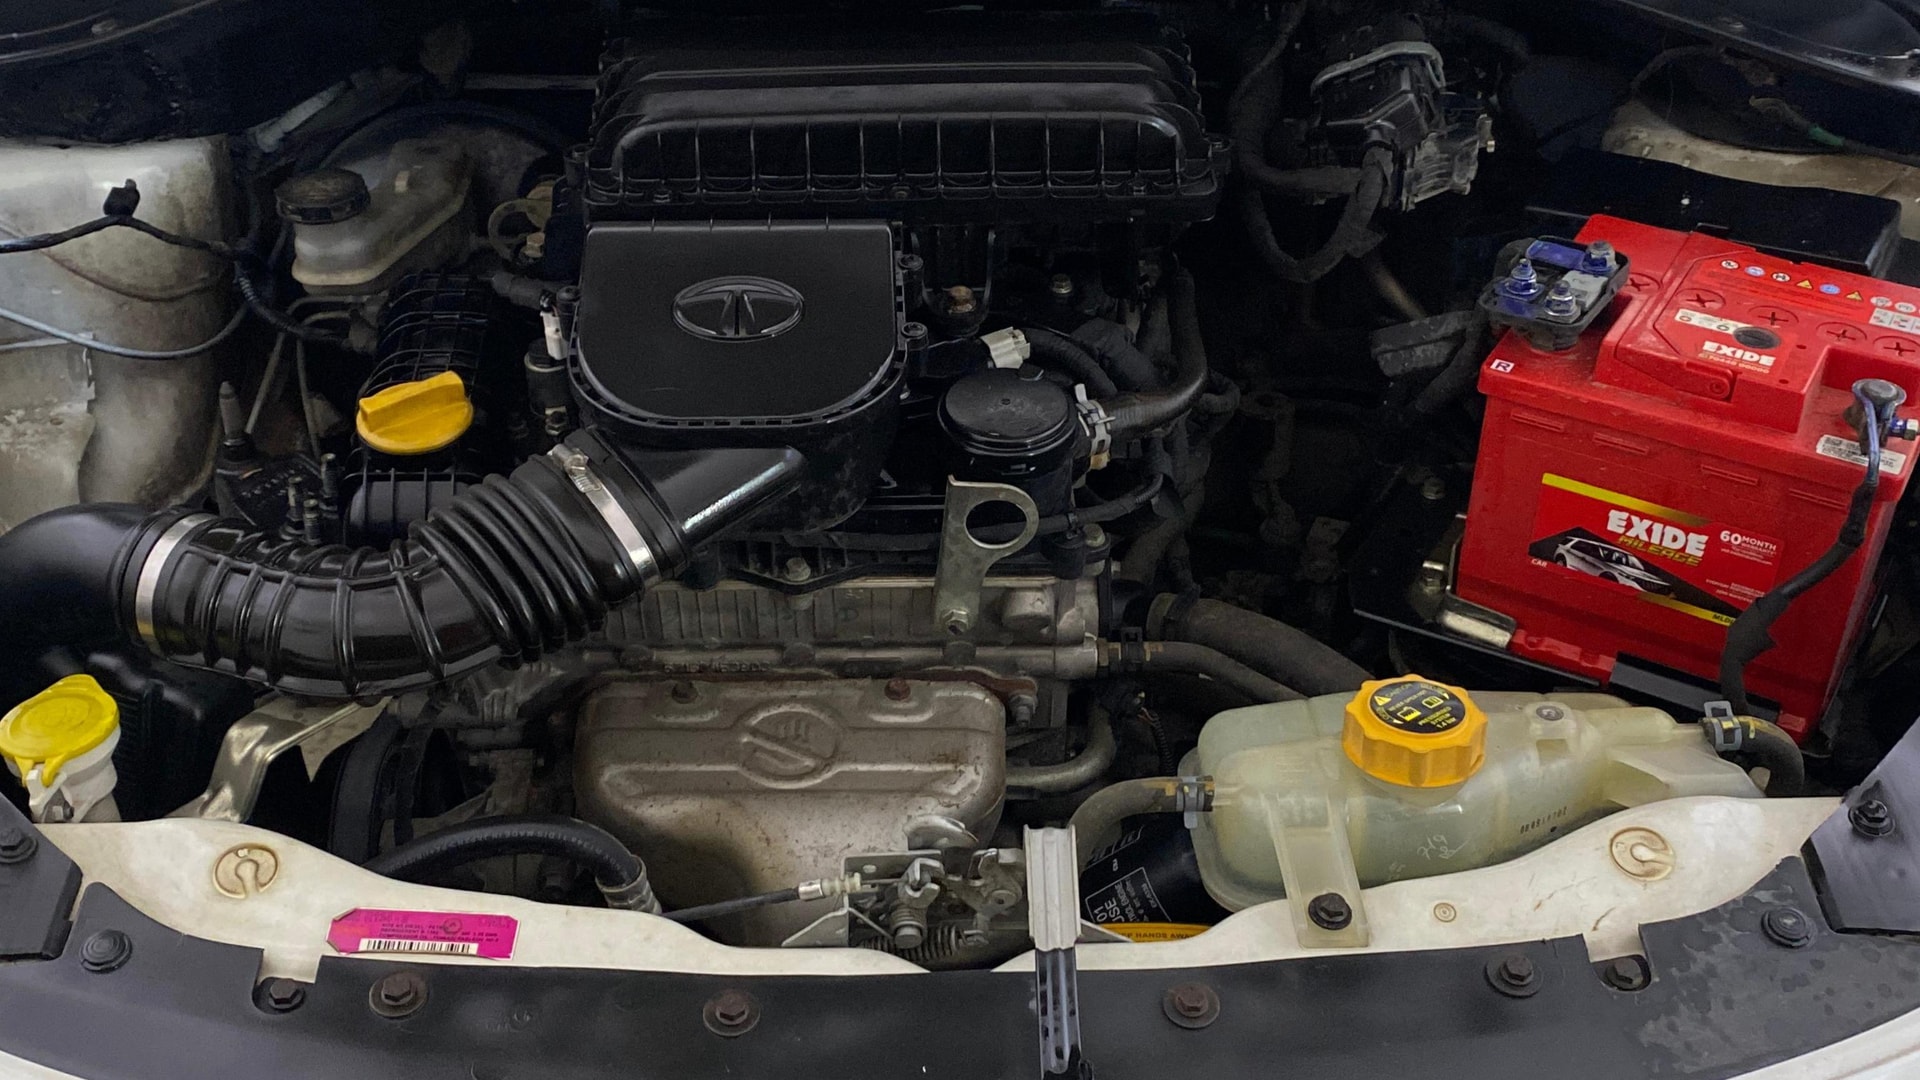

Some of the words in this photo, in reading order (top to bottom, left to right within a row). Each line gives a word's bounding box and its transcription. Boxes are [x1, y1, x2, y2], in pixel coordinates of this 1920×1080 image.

[1702, 340, 1776, 367] EXIDE
[1495, 361, 1511, 371] R
[1606, 509, 1709, 558] EXIDE
[1720, 530, 1742, 545] 60
[1742, 536, 1777, 551] MONTH
[1531, 558, 1548, 568] CAR
[1617, 535, 1703, 567] MILEAGE
